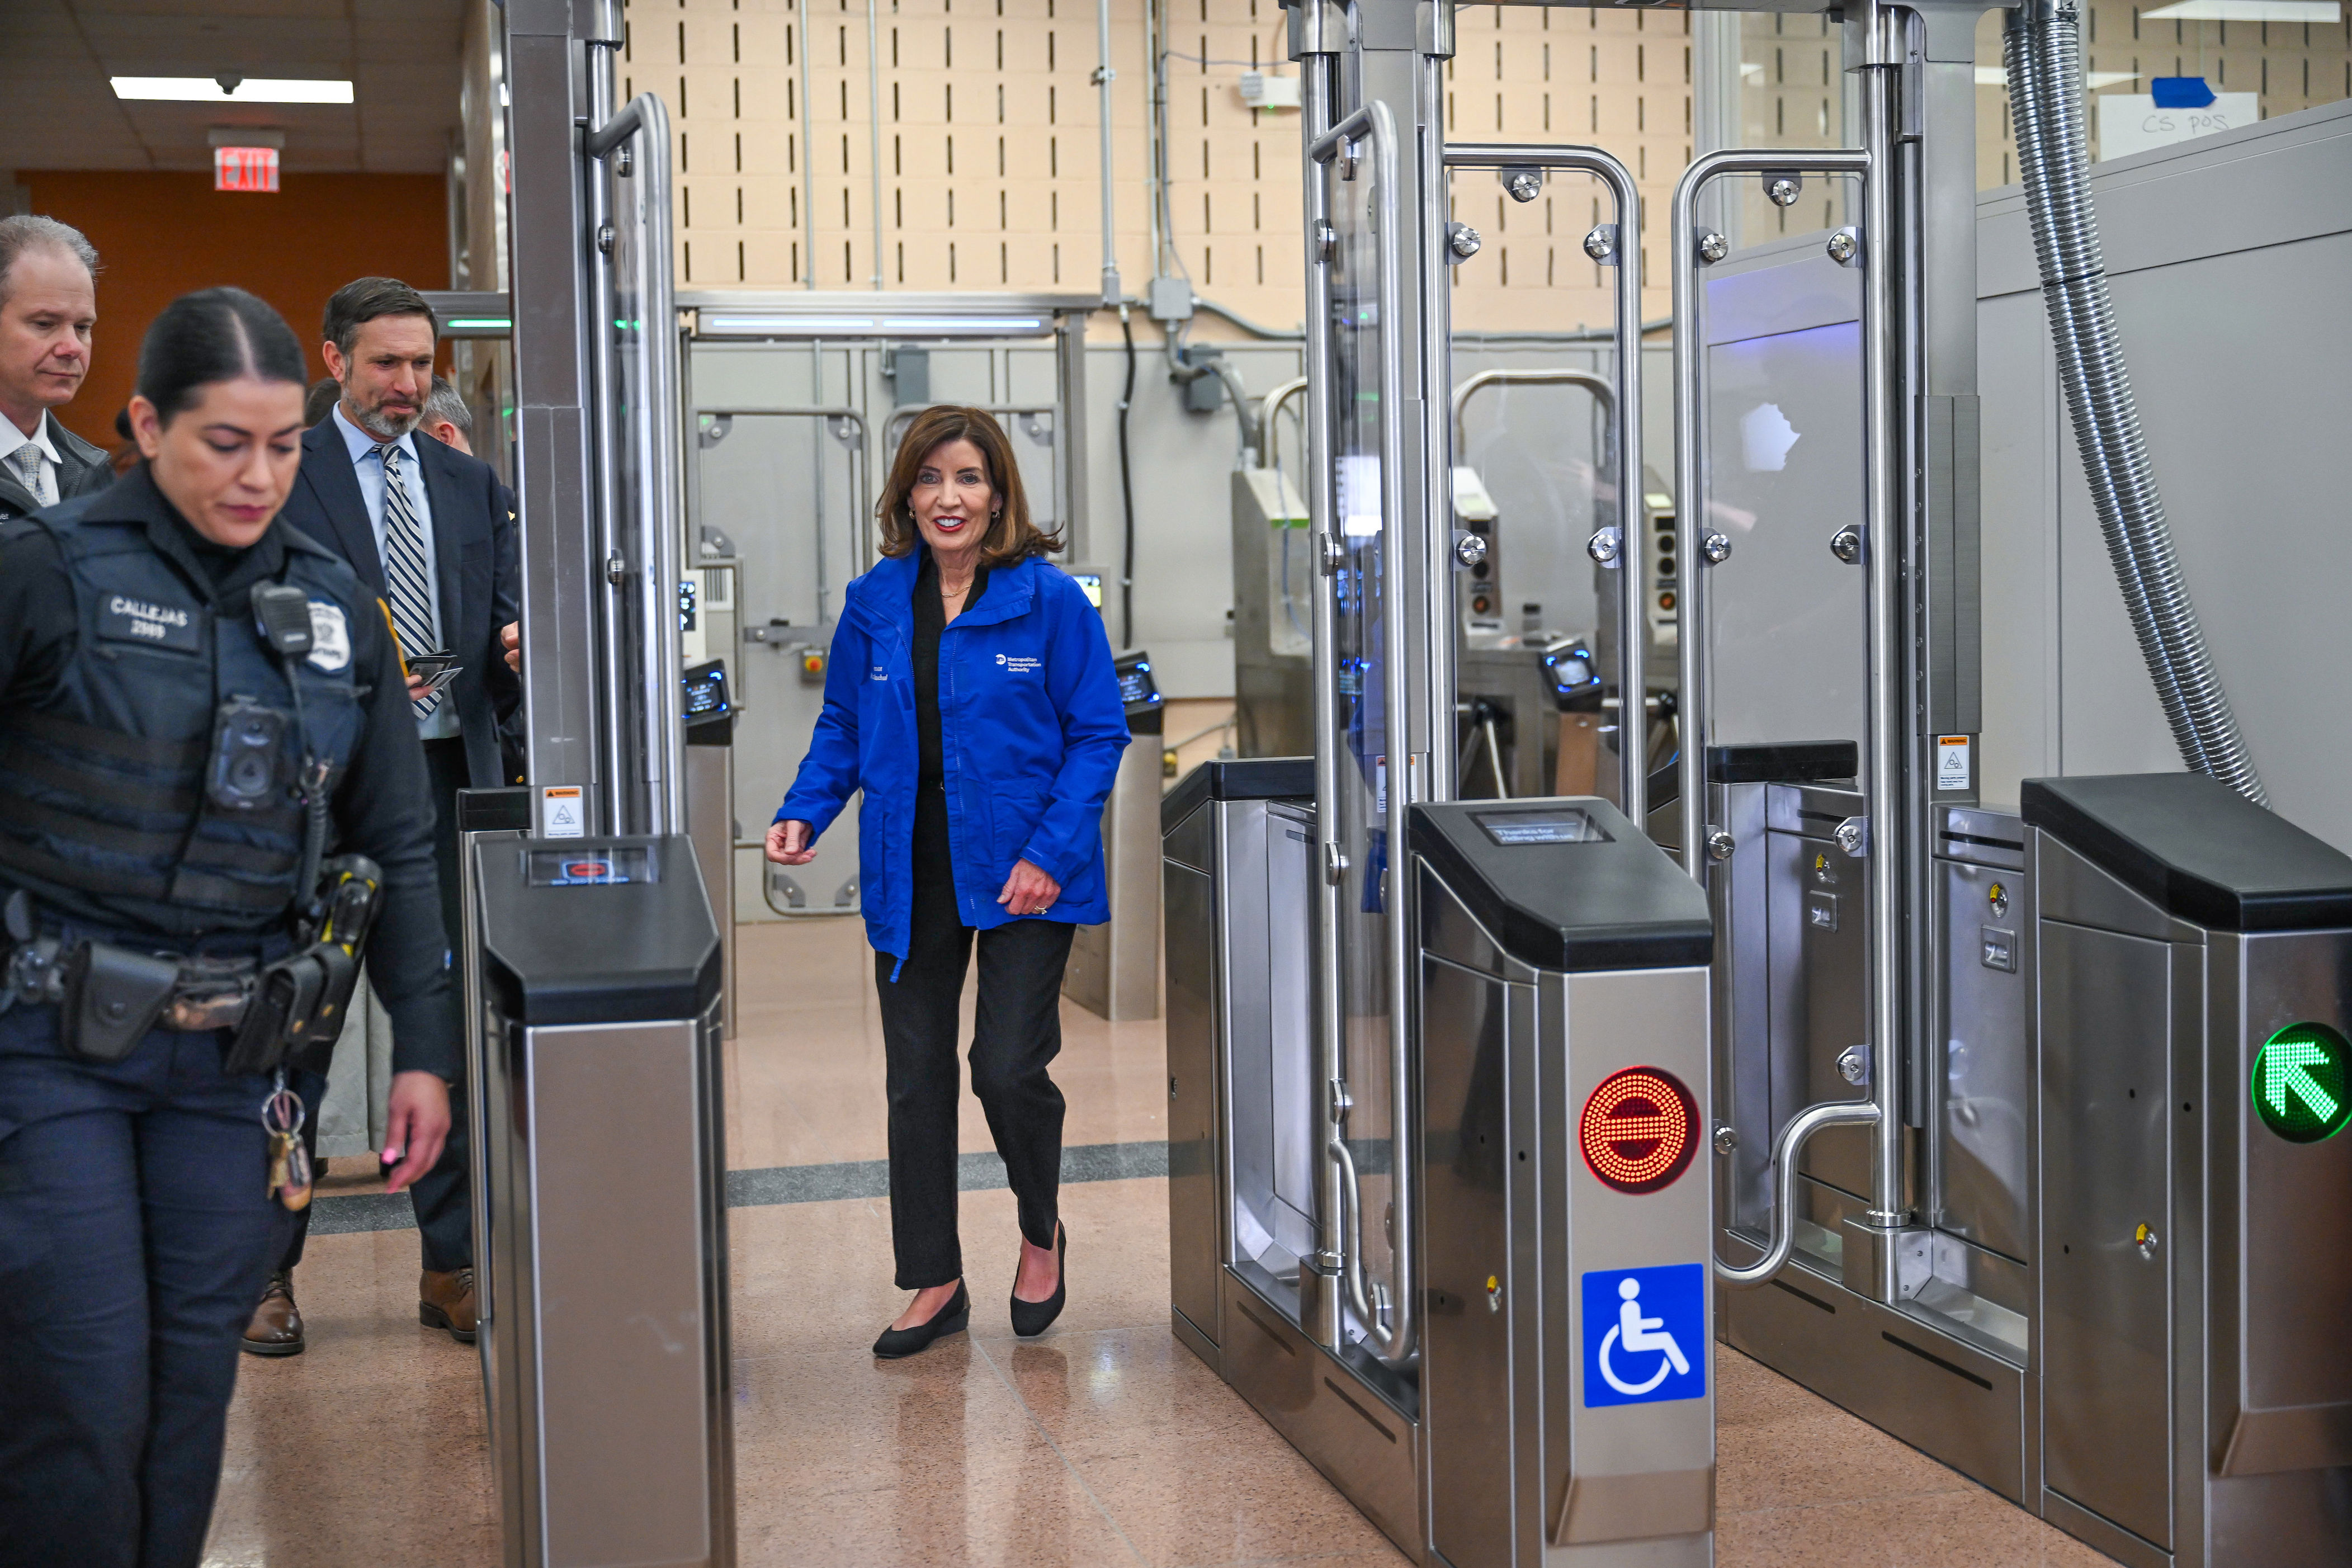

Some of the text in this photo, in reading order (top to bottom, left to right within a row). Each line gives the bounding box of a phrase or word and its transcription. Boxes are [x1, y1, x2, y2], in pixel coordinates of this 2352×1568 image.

[2142, 115, 2175, 133] CS
[221, 147, 273, 191] EXIT
[111, 596, 188, 626] CALLEJAS
